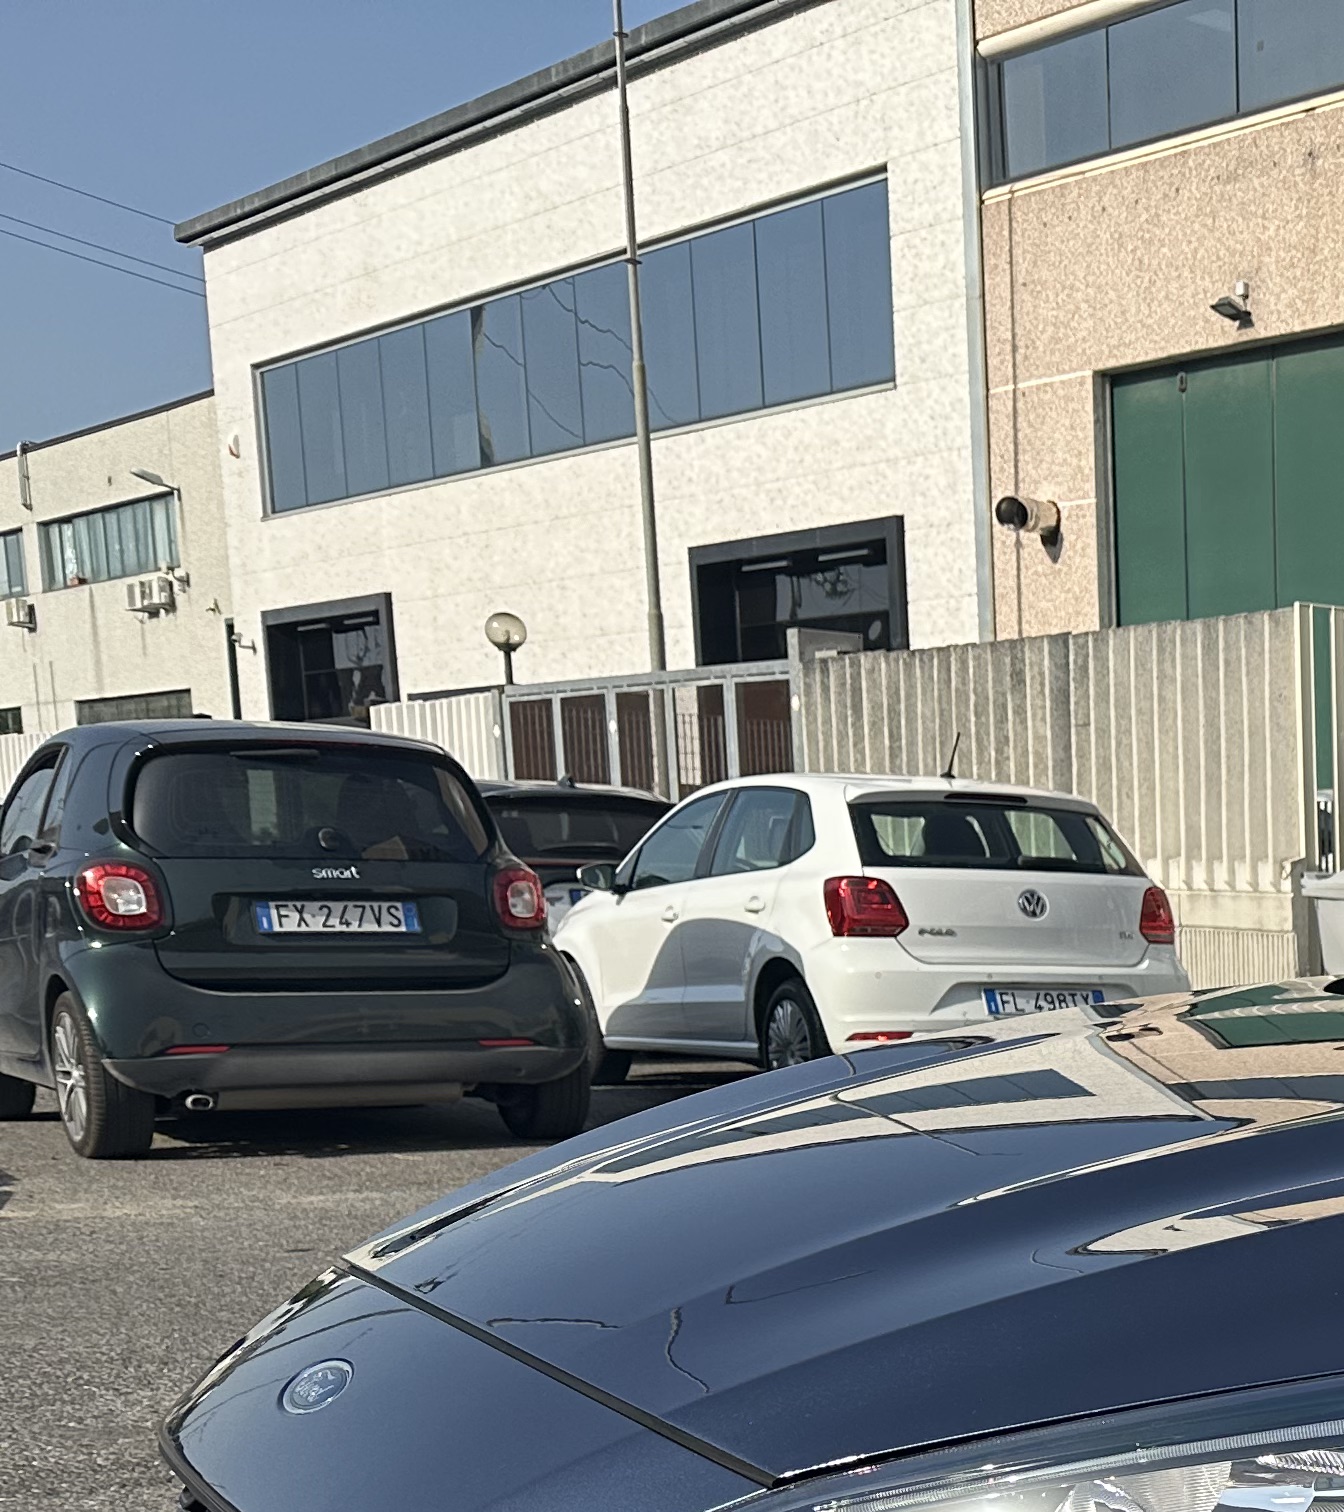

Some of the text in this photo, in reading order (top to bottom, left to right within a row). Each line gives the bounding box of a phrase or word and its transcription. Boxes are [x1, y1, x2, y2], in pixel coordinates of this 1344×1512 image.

[312, 866, 360, 879] smart
[274, 903, 402, 928] FX 247VS
[998, 991, 1090, 1012] FL 498TY
